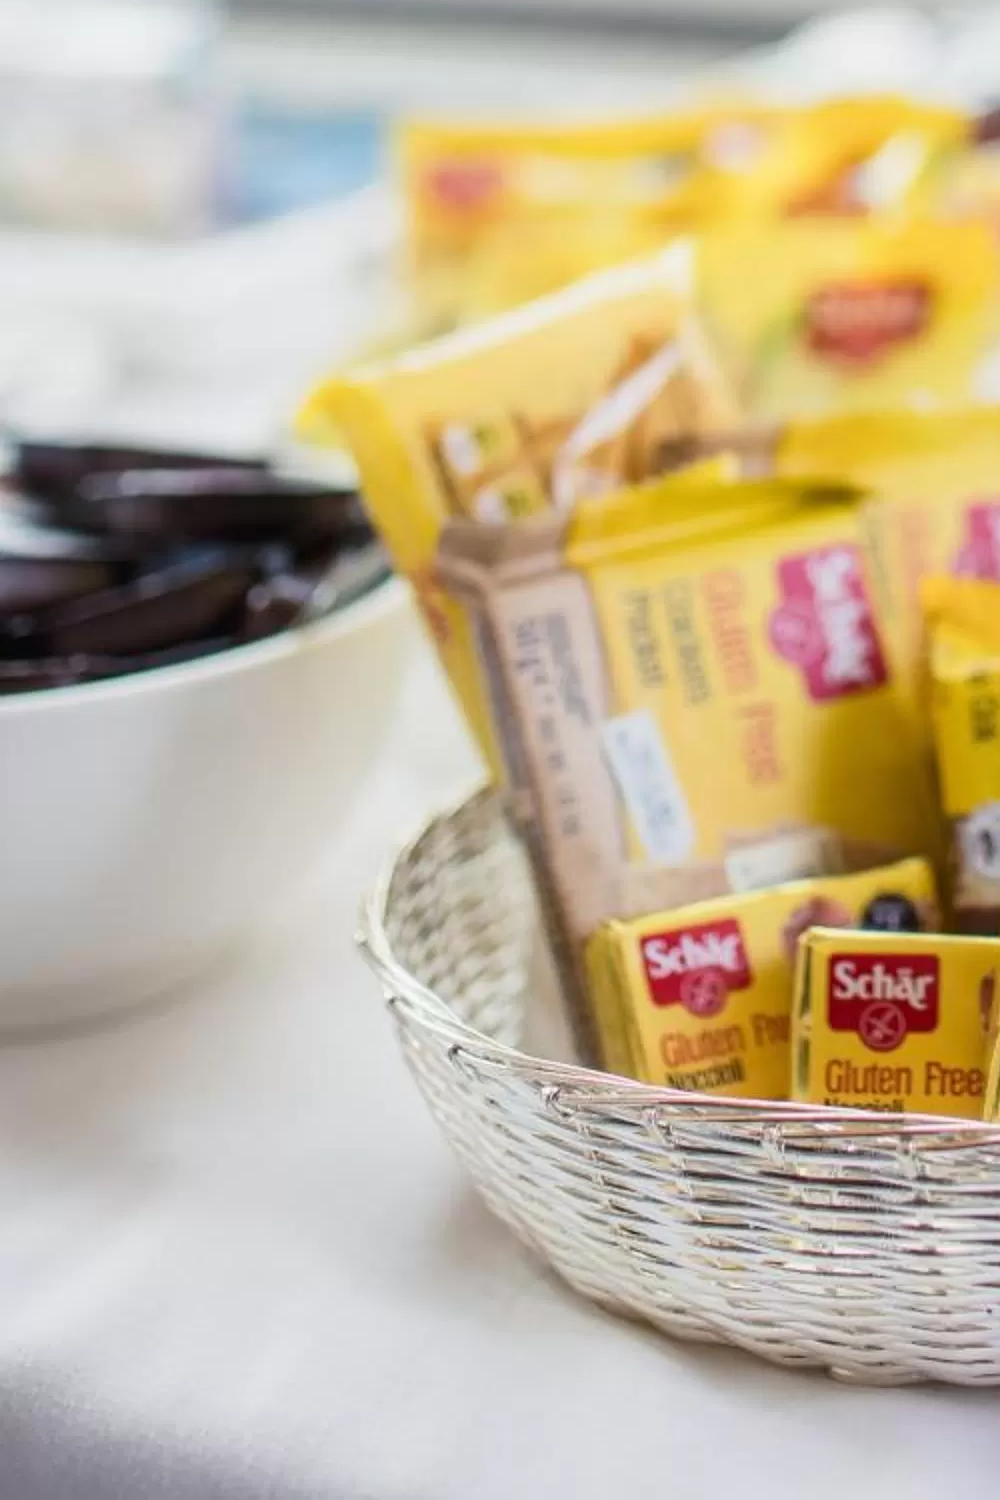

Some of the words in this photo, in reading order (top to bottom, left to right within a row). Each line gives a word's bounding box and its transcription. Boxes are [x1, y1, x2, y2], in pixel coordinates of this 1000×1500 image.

[833, 960, 936, 1012] Schär
[825, 1059, 913, 1097] Gluten
[923, 1060, 985, 1098] Free
